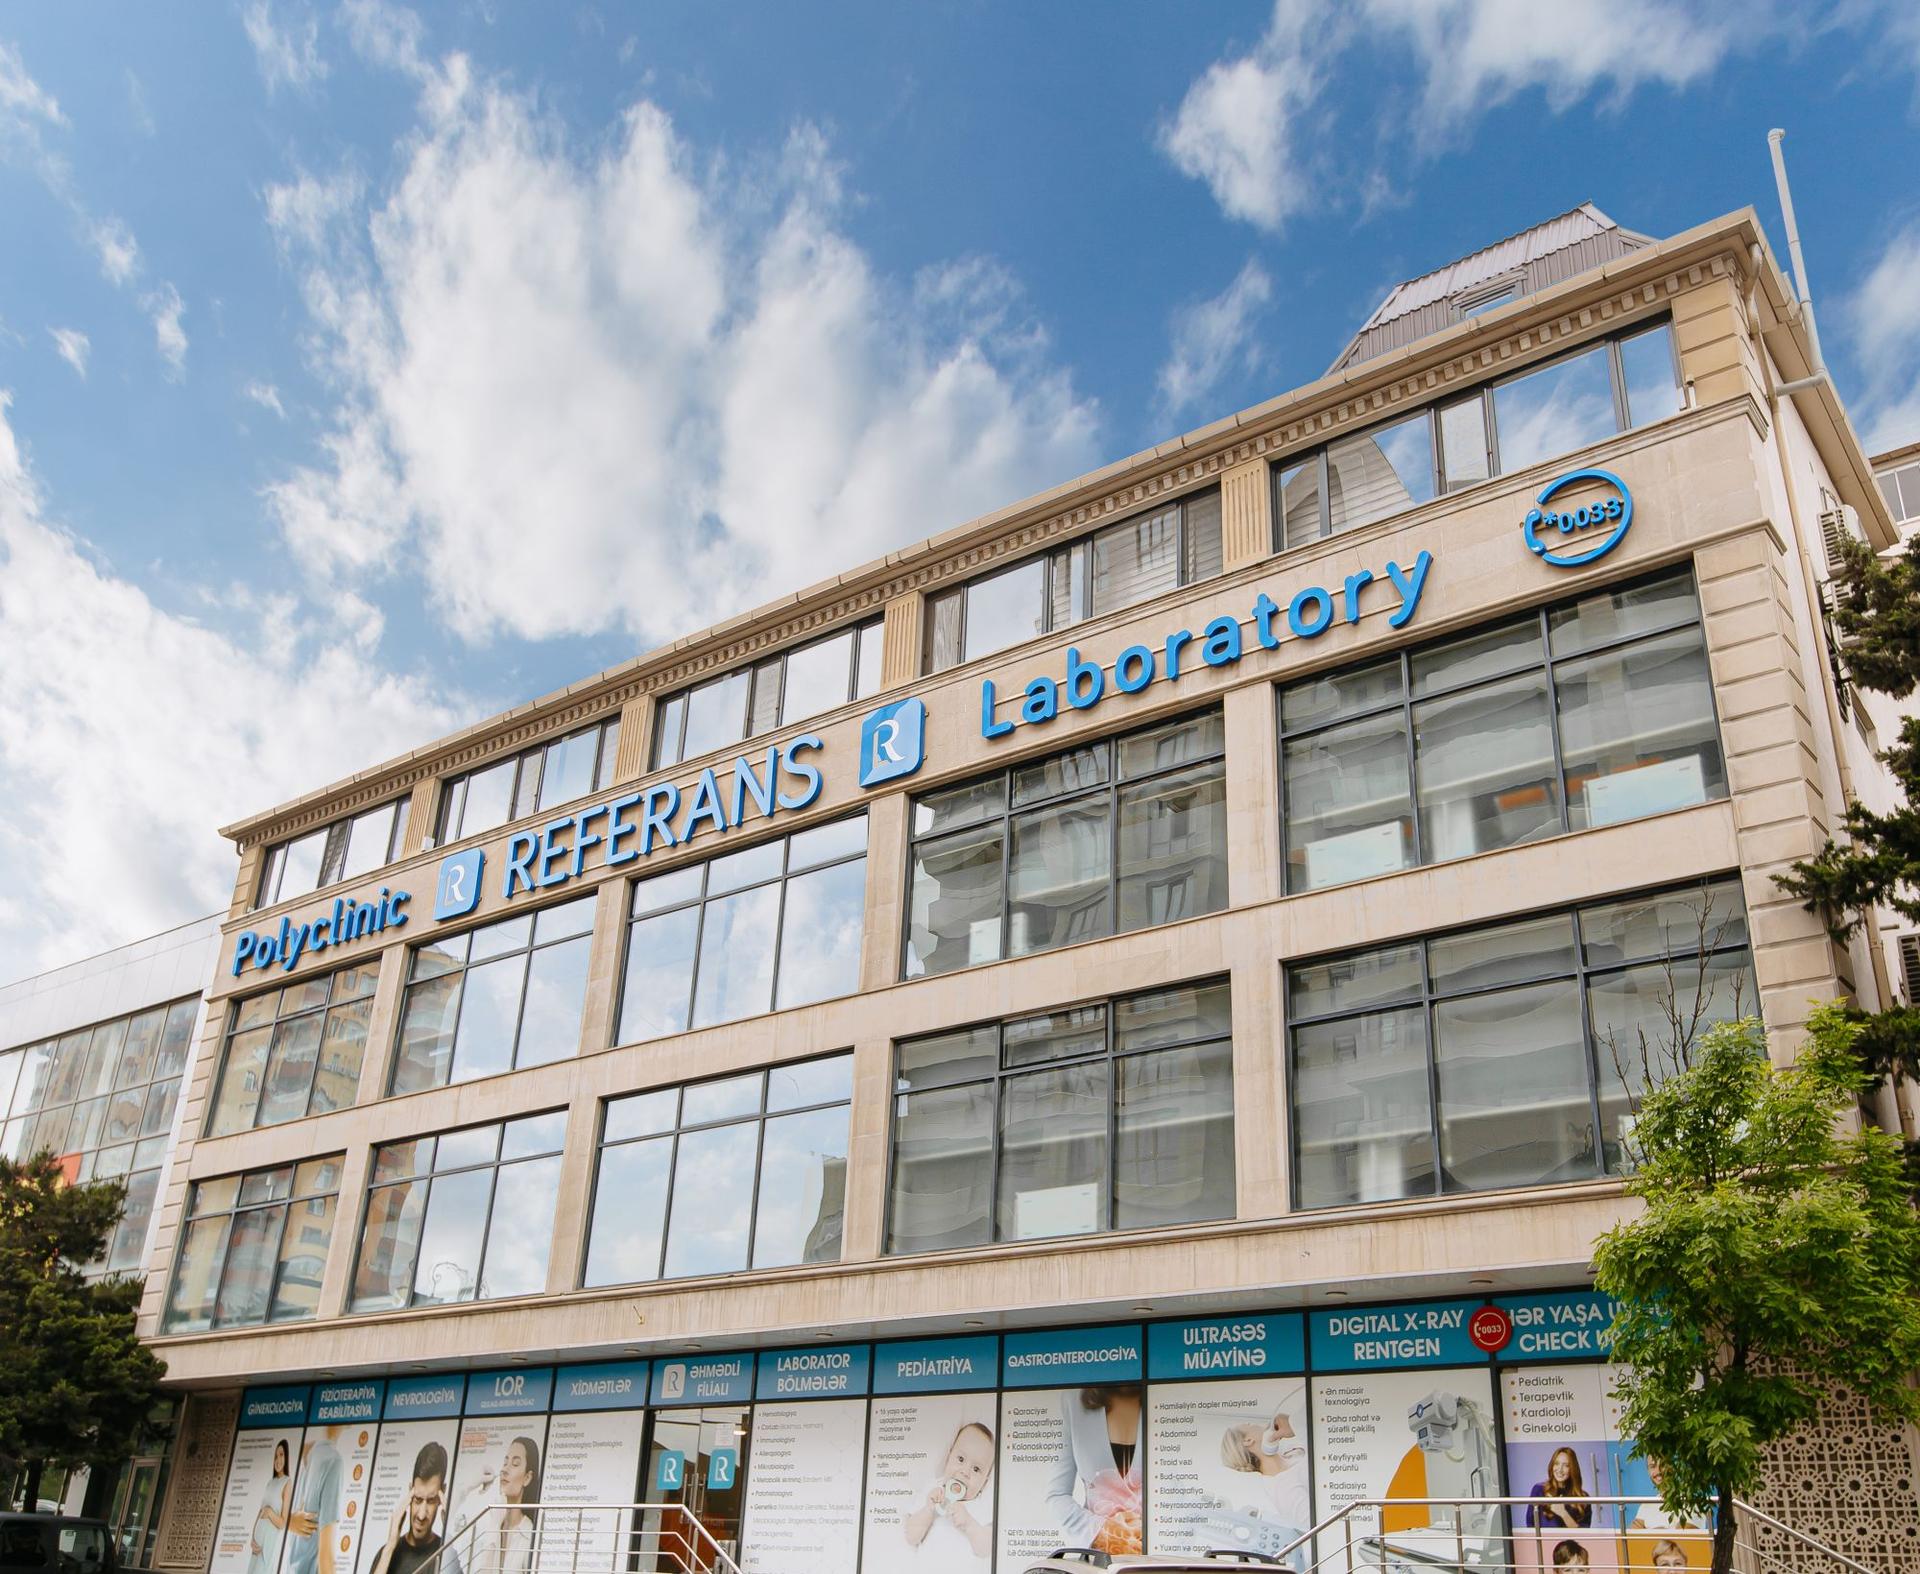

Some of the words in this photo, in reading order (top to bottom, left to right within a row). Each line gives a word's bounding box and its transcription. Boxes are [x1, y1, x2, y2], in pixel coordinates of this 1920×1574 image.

[981, 550, 1434, 740] Laboratory
[503, 734, 825, 899] REFERANS
[231, 887, 412, 977] Polyclinic
[1329, 1313, 1401, 1336] DIGITAL
[1404, 1309, 1465, 1331] X-RAY
[1549, 1303, 1604, 1327] YAŞA
[1183, 1323, 1266, 1346] ULTRASƏS
[1519, 1330, 1591, 1352] CHECK
[1008, 1345, 1139, 1368] QASTROENTEROLOGİYA
[1183, 1346, 1267, 1370] MÜAYİNƏ
[1354, 1337, 1441, 1361] RENTGEN
[690, 1360, 741, 1378] ƏHMƏDLİ
[777, 1353, 850, 1372] LABORATOR
[897, 1356, 973, 1378] PEDİATRİYA
[495, 1376, 525, 1397] LOR
[571, 1378, 632, 1396] XİDMƏTLƏR
[697, 1381, 729, 1397] FİLİALI
[777, 1375, 848, 1393] BÖLMƏLƏR
[1519, 1376, 1564, 1387] Pediatrik
[320, 1384, 377, 1402] FİZİOTERAPİYA
[392, 1387, 456, 1407] NEVROLOGİYA
[1519, 1392, 1574, 1403] Terapevtik
[247, 1398, 304, 1416] GİNEKOLOGİYA
[318, 1402, 373, 1420] REABİLİTASİYA
[1520, 1408, 1571, 1420] Kardioloji
[1521, 1423, 1577, 1436] Ginekoloji
